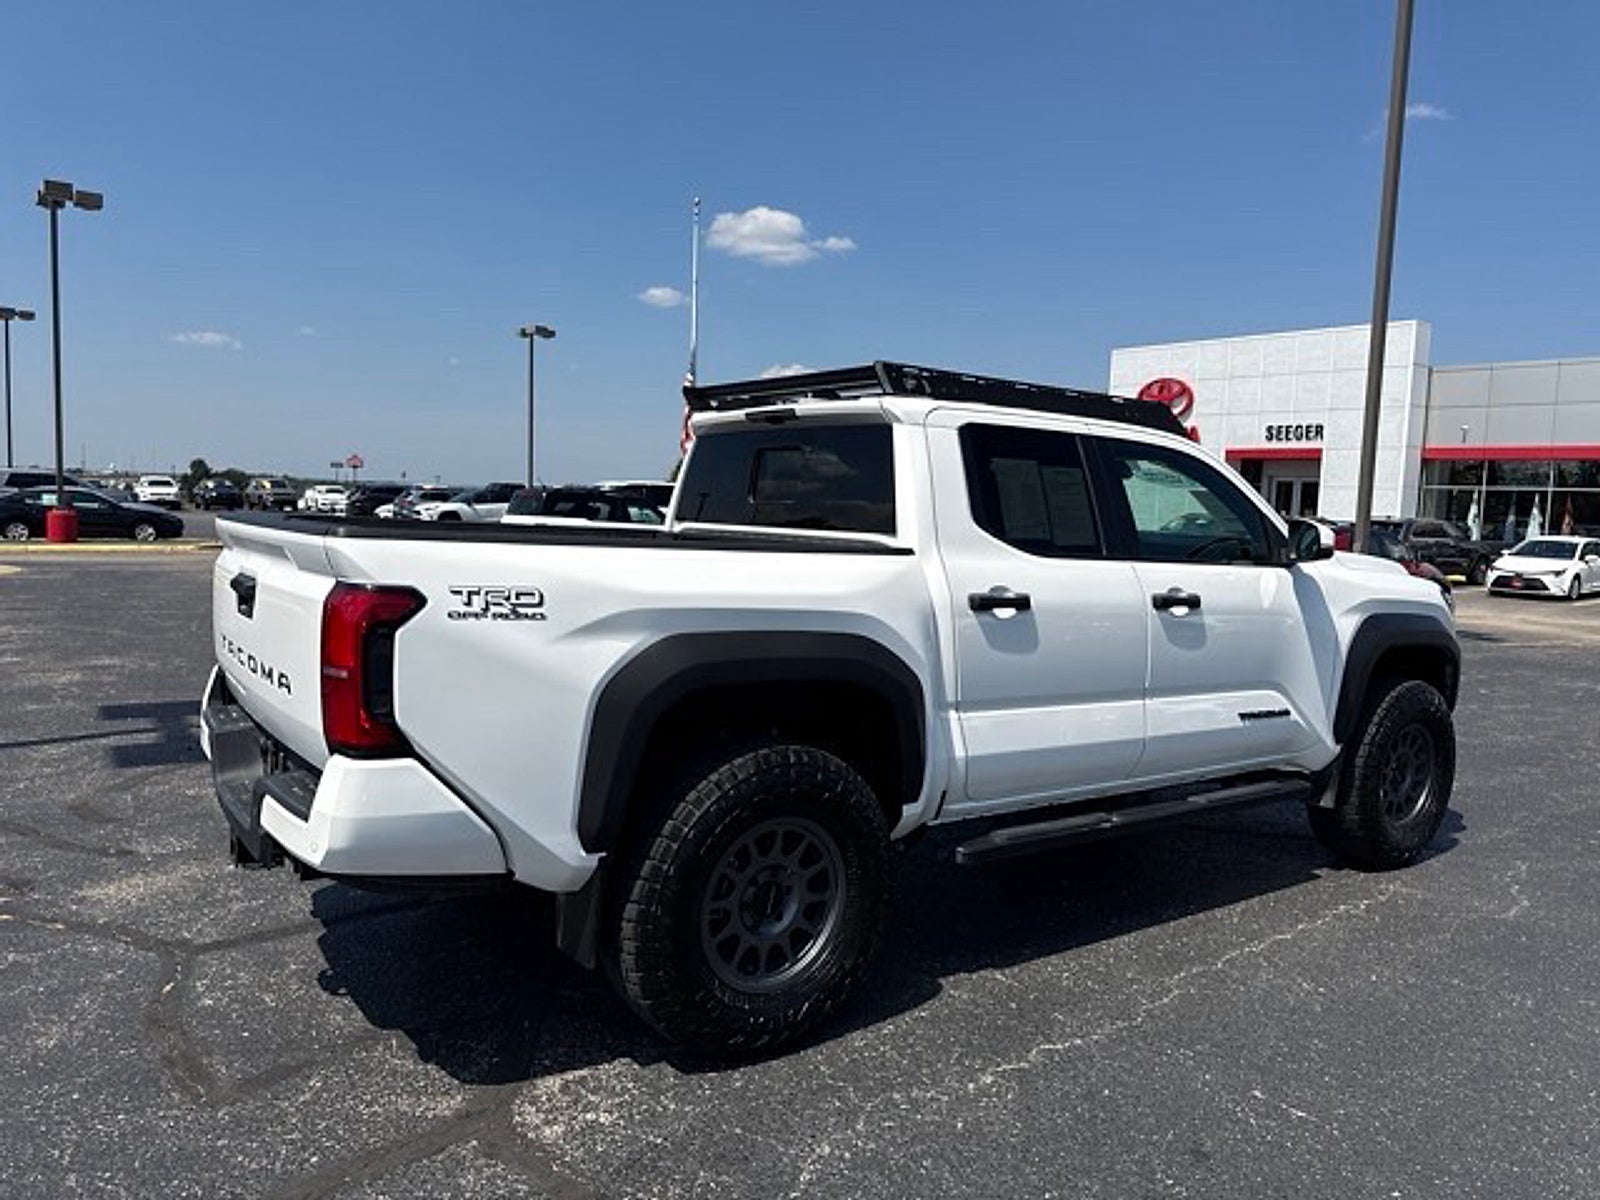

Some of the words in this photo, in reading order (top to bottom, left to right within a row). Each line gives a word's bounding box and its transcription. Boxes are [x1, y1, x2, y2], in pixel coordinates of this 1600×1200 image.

[1265, 423, 1324, 442] SEEGER
[448, 586, 544, 612] TRD
[220, 632, 292, 696] TACOMA
